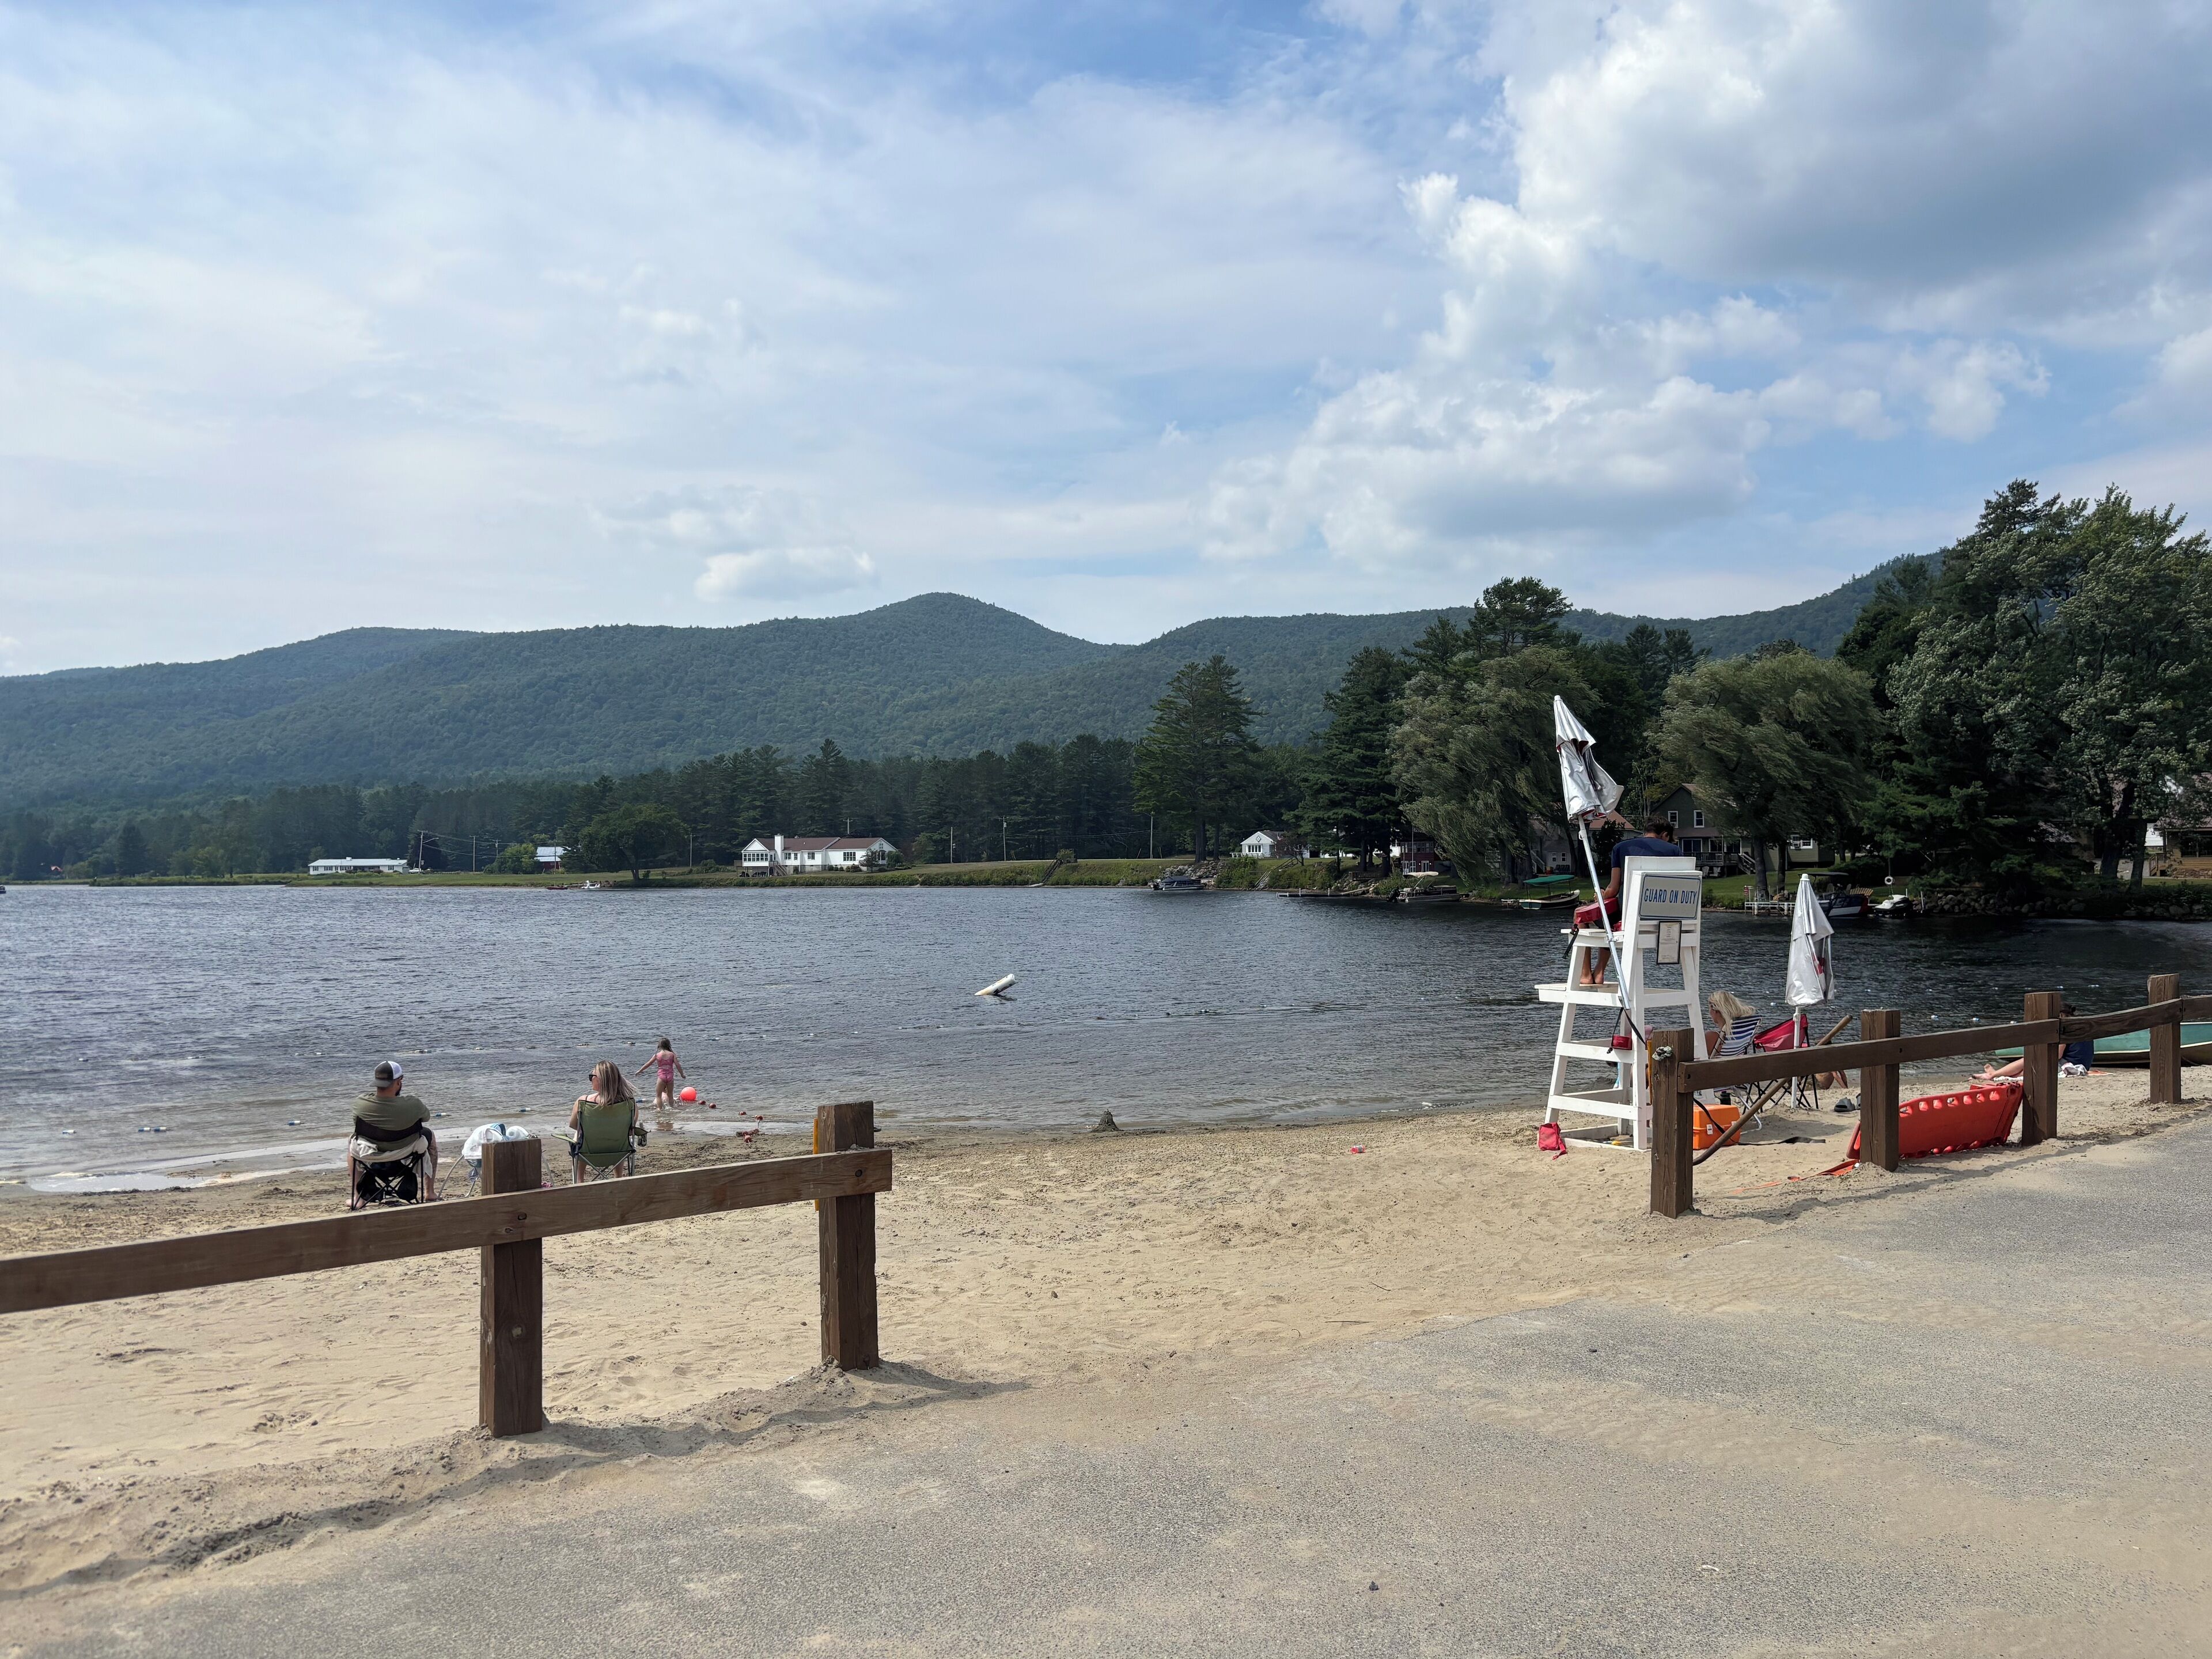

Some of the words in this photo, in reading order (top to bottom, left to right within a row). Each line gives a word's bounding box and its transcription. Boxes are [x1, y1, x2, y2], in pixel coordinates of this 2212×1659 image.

[1644, 888, 1666, 903] GUARD
[1669, 889, 1679, 903] ON
[1680, 890, 1697, 904] DUTY
